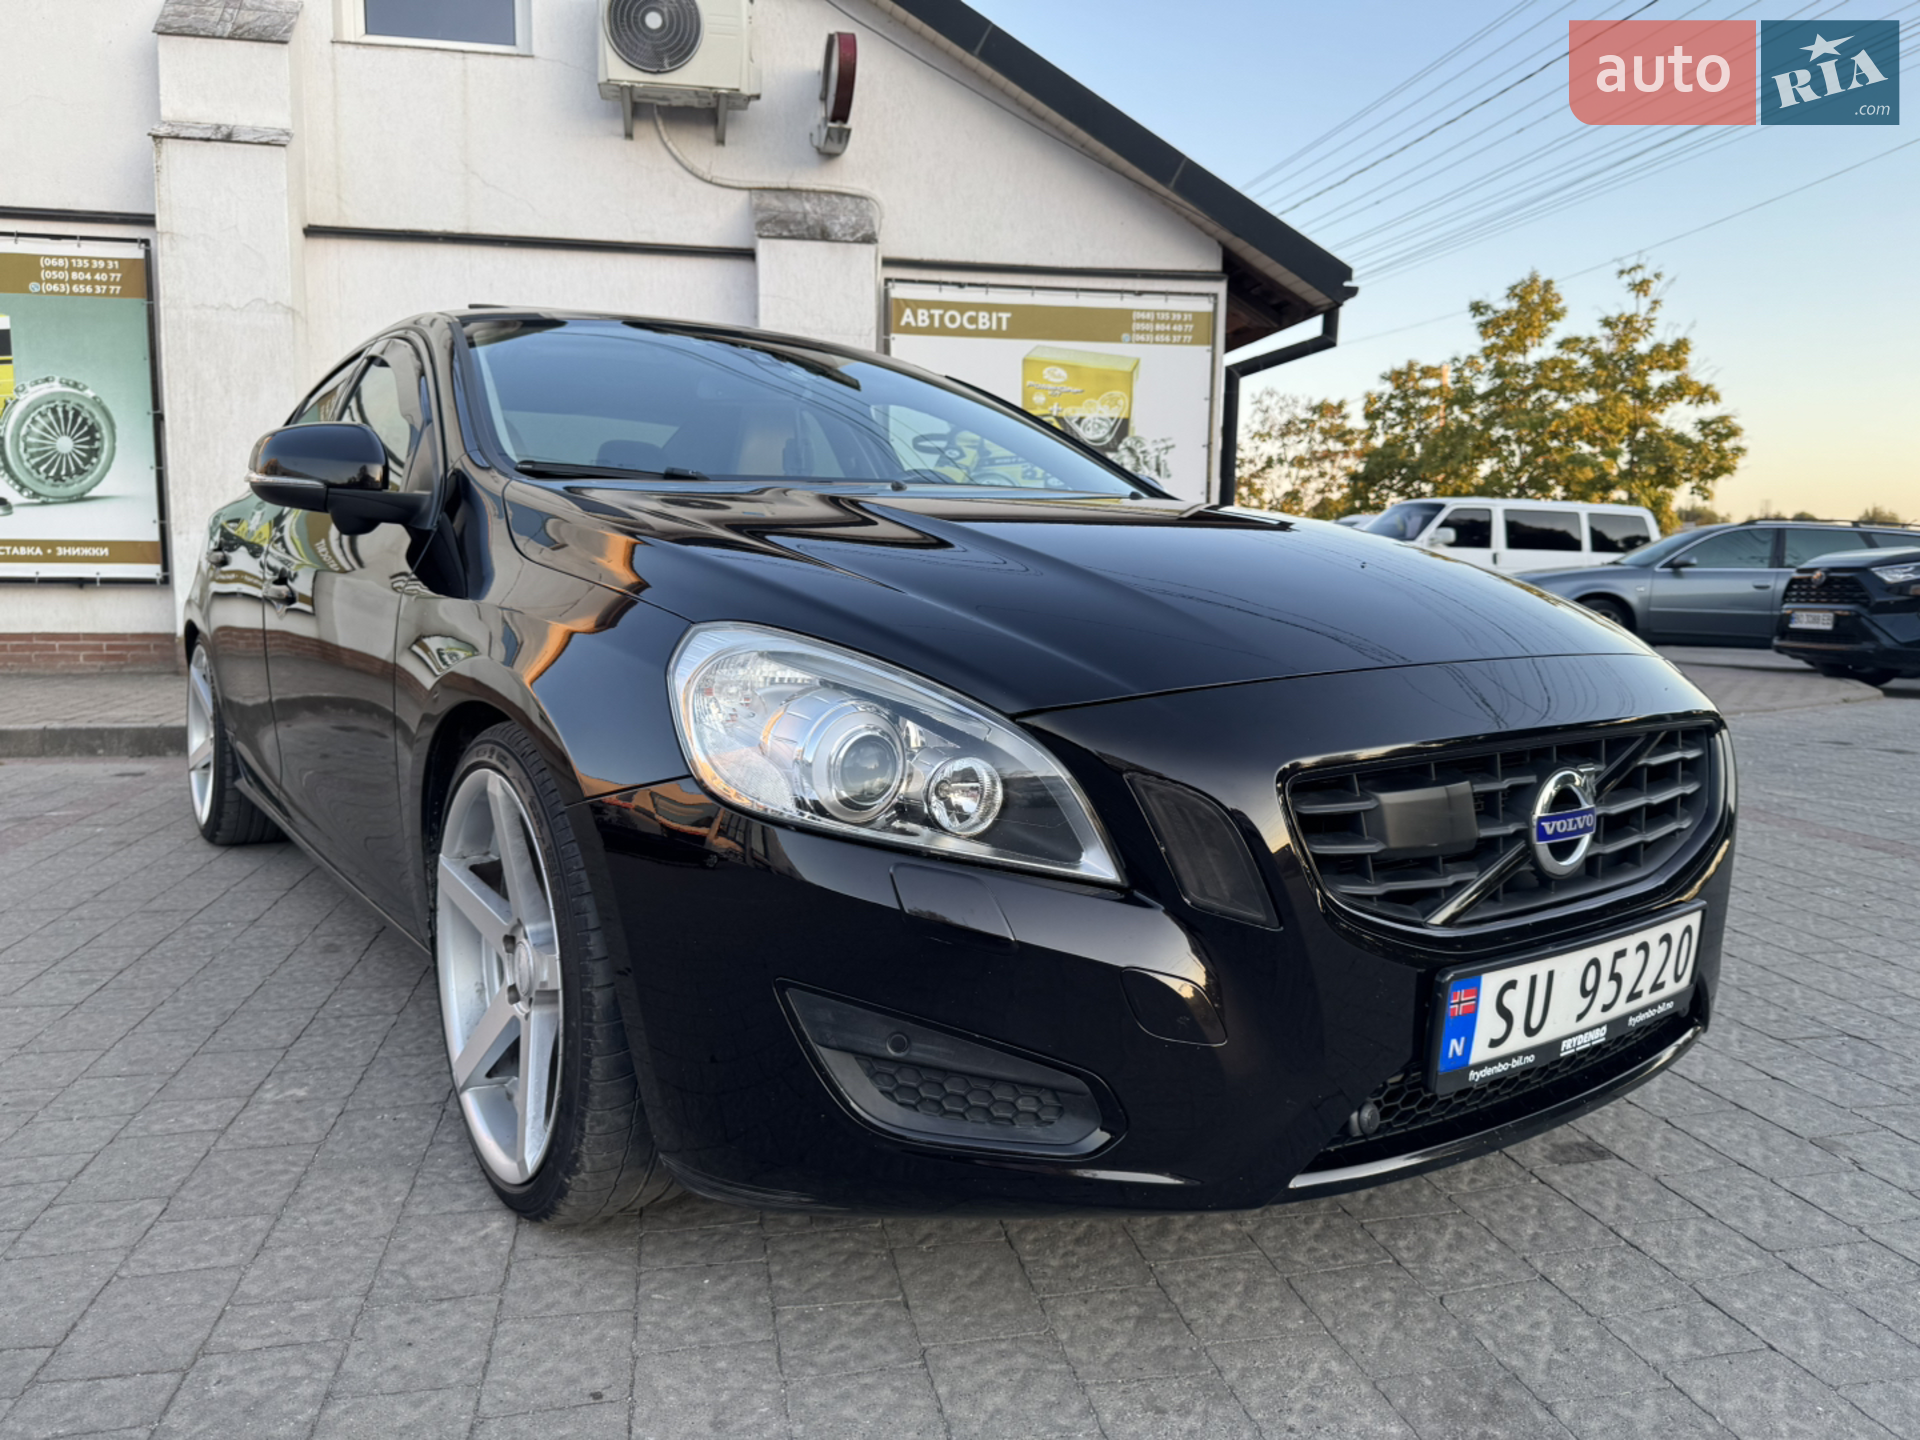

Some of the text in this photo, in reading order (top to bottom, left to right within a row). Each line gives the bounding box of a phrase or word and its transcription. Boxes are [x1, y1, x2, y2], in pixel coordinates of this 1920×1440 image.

[40, 256, 120, 270] (068) 135 39 31
[40, 269, 122, 282] (050) 804 40 77
[41, 282, 122, 295] (063) 656 37 77
[900, 308, 1012, 331] АВТОСВІТ
[56, 546, 109, 557] ЗНИЖКИ
[1541, 814, 1594, 835] VOLVO
[1488, 924, 1694, 1049] SU 95220
[1448, 1037, 1466, 1059] N
[1468, 1053, 1535, 1082] frydenbo-bil.no
